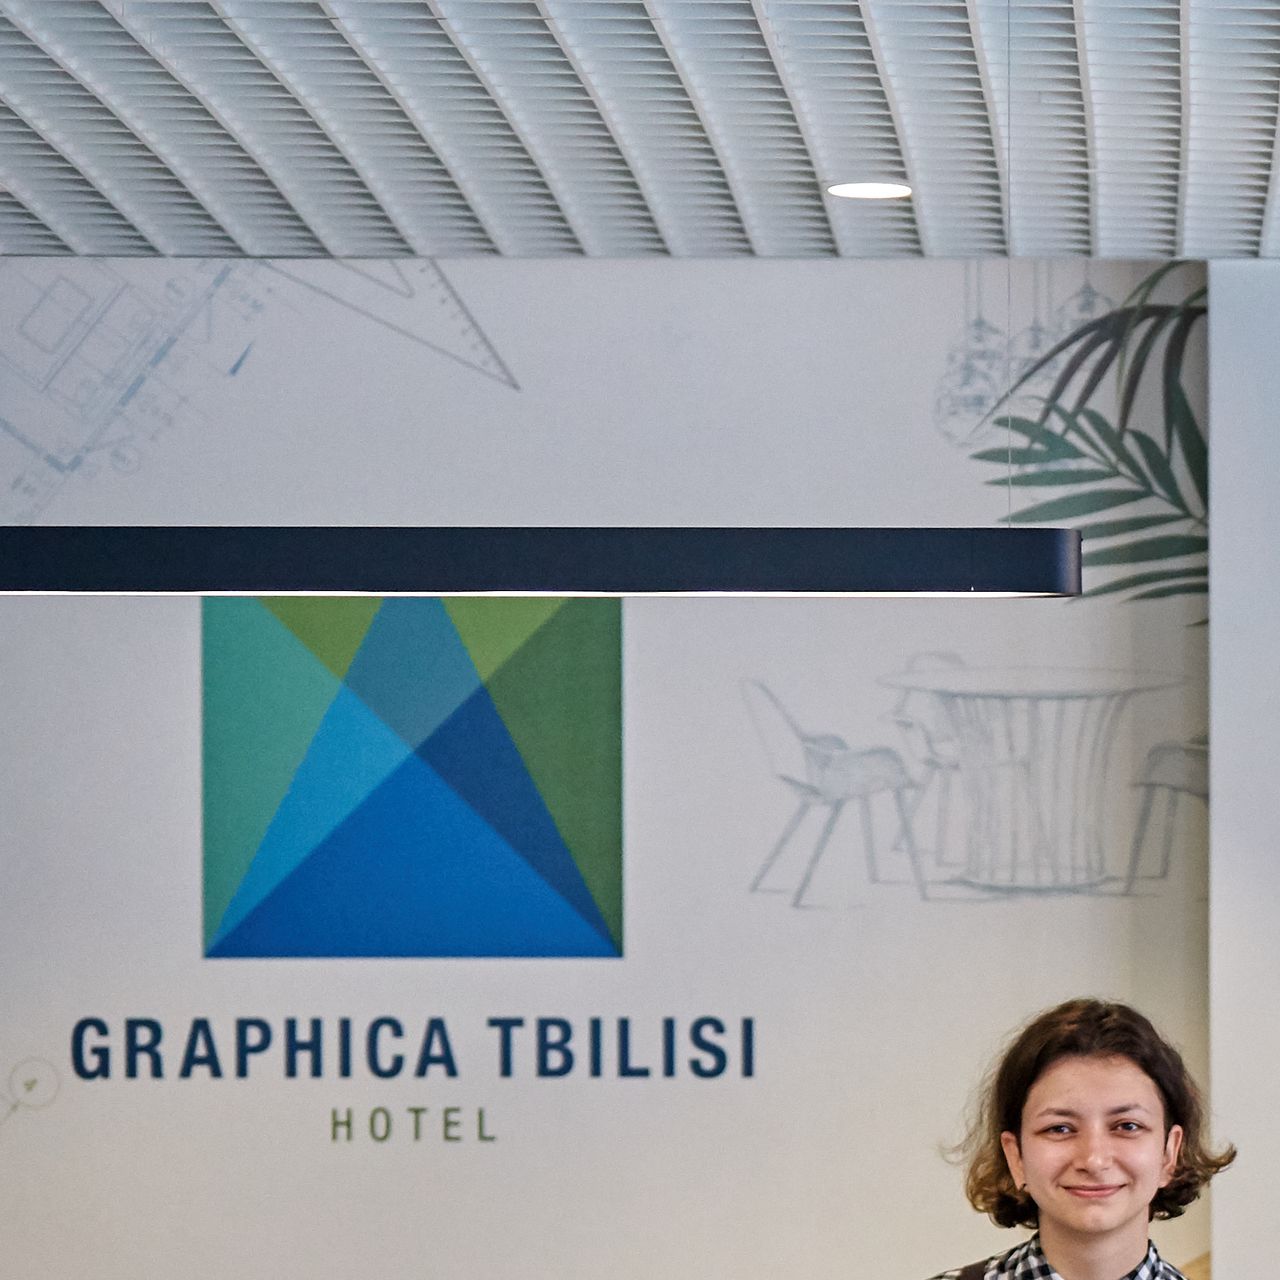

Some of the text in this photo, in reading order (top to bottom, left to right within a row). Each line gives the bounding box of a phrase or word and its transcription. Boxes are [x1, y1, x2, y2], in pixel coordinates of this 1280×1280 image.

[71, 1016, 755, 1081] GRAPHICA TBILISI
[332, 1107, 498, 1143] HOTEL
